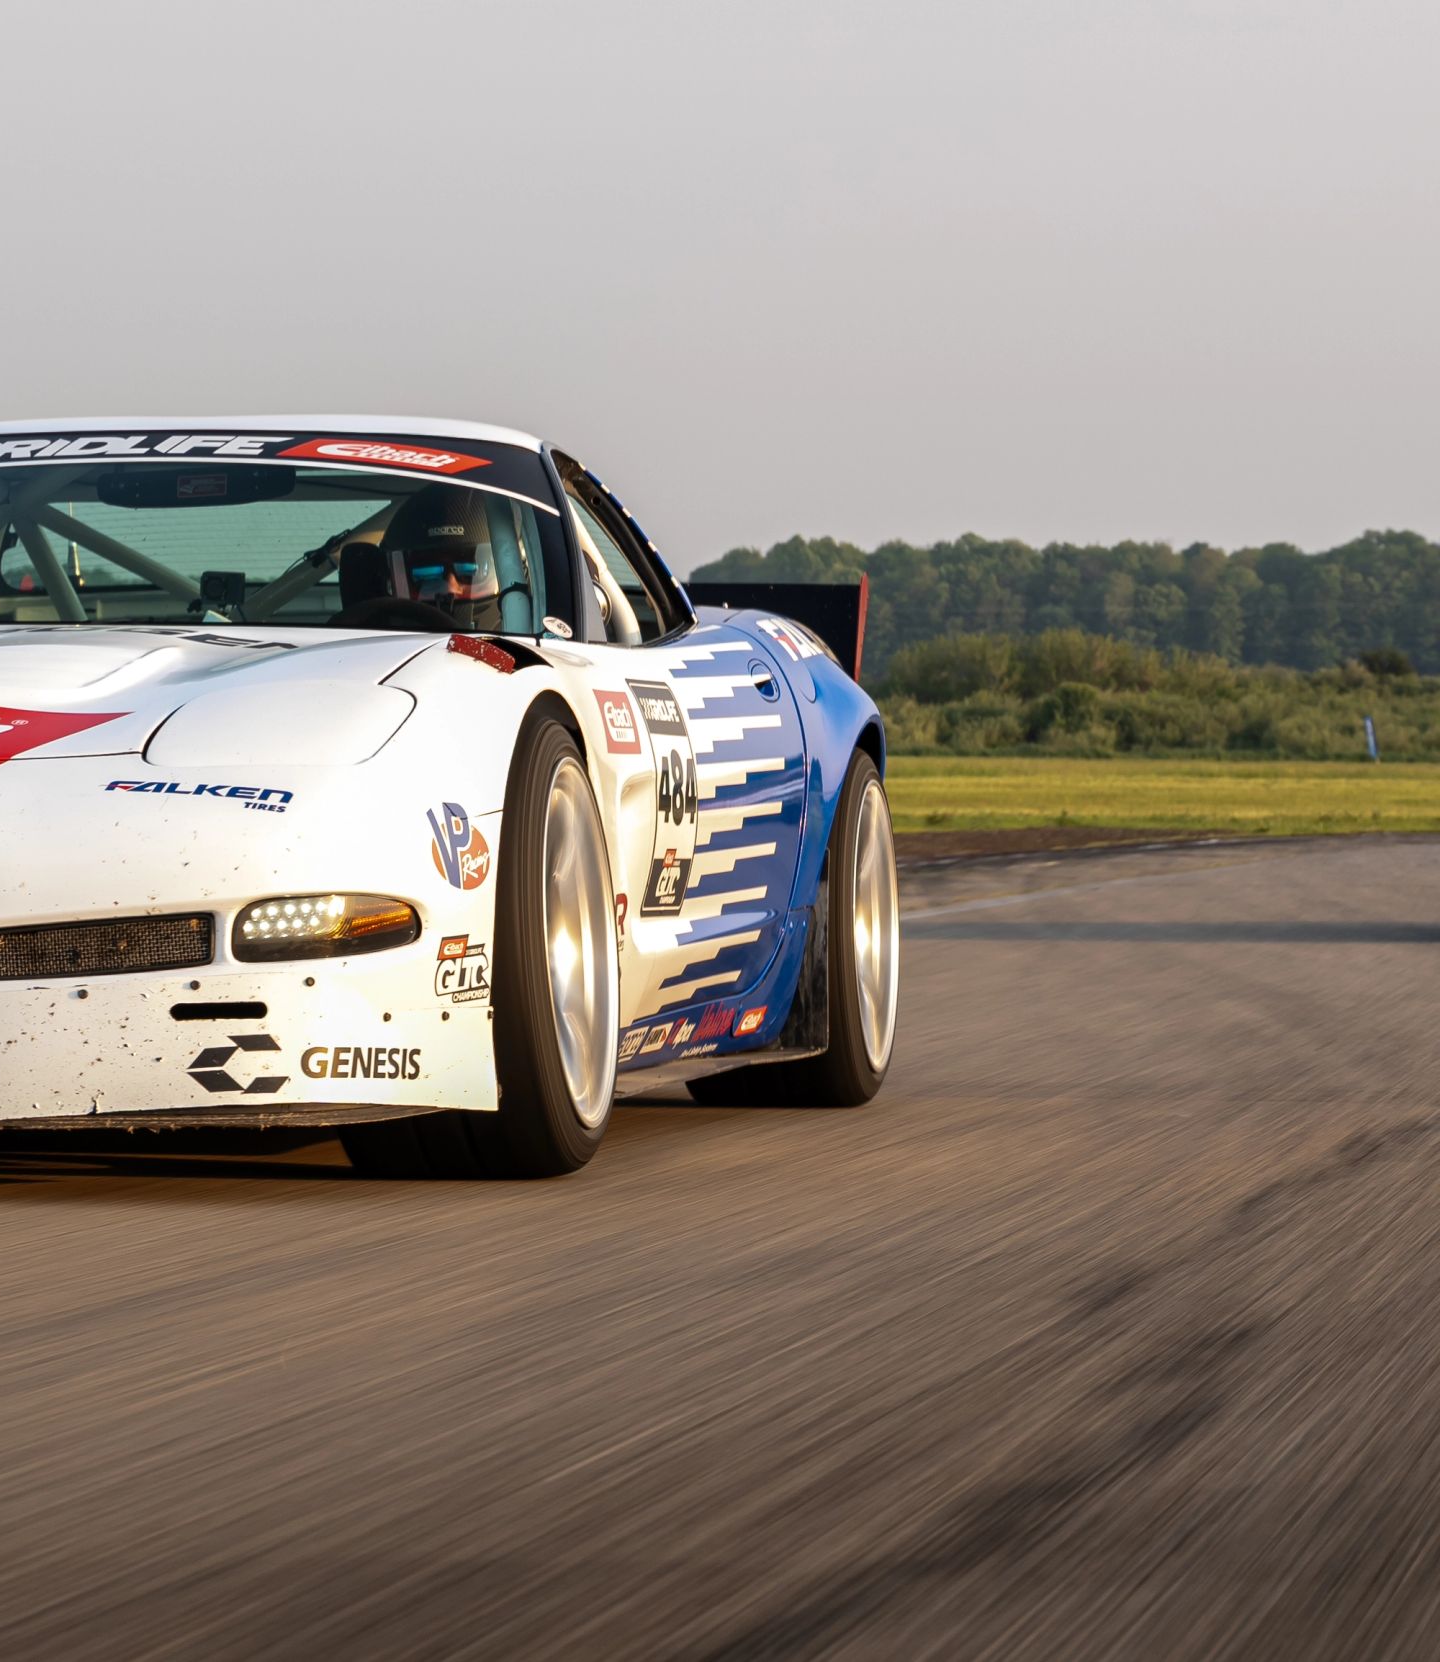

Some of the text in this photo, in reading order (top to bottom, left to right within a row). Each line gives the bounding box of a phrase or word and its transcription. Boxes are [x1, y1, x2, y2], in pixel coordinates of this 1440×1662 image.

[316, 443, 456, 468] Eibach
[105, 780, 293, 804] FALKEN
[659, 749, 696, 826] 484
[244, 802, 286, 813] TIRES
[426, 802, 470, 889] VP
[300, 1046, 422, 1080] GENESIS
